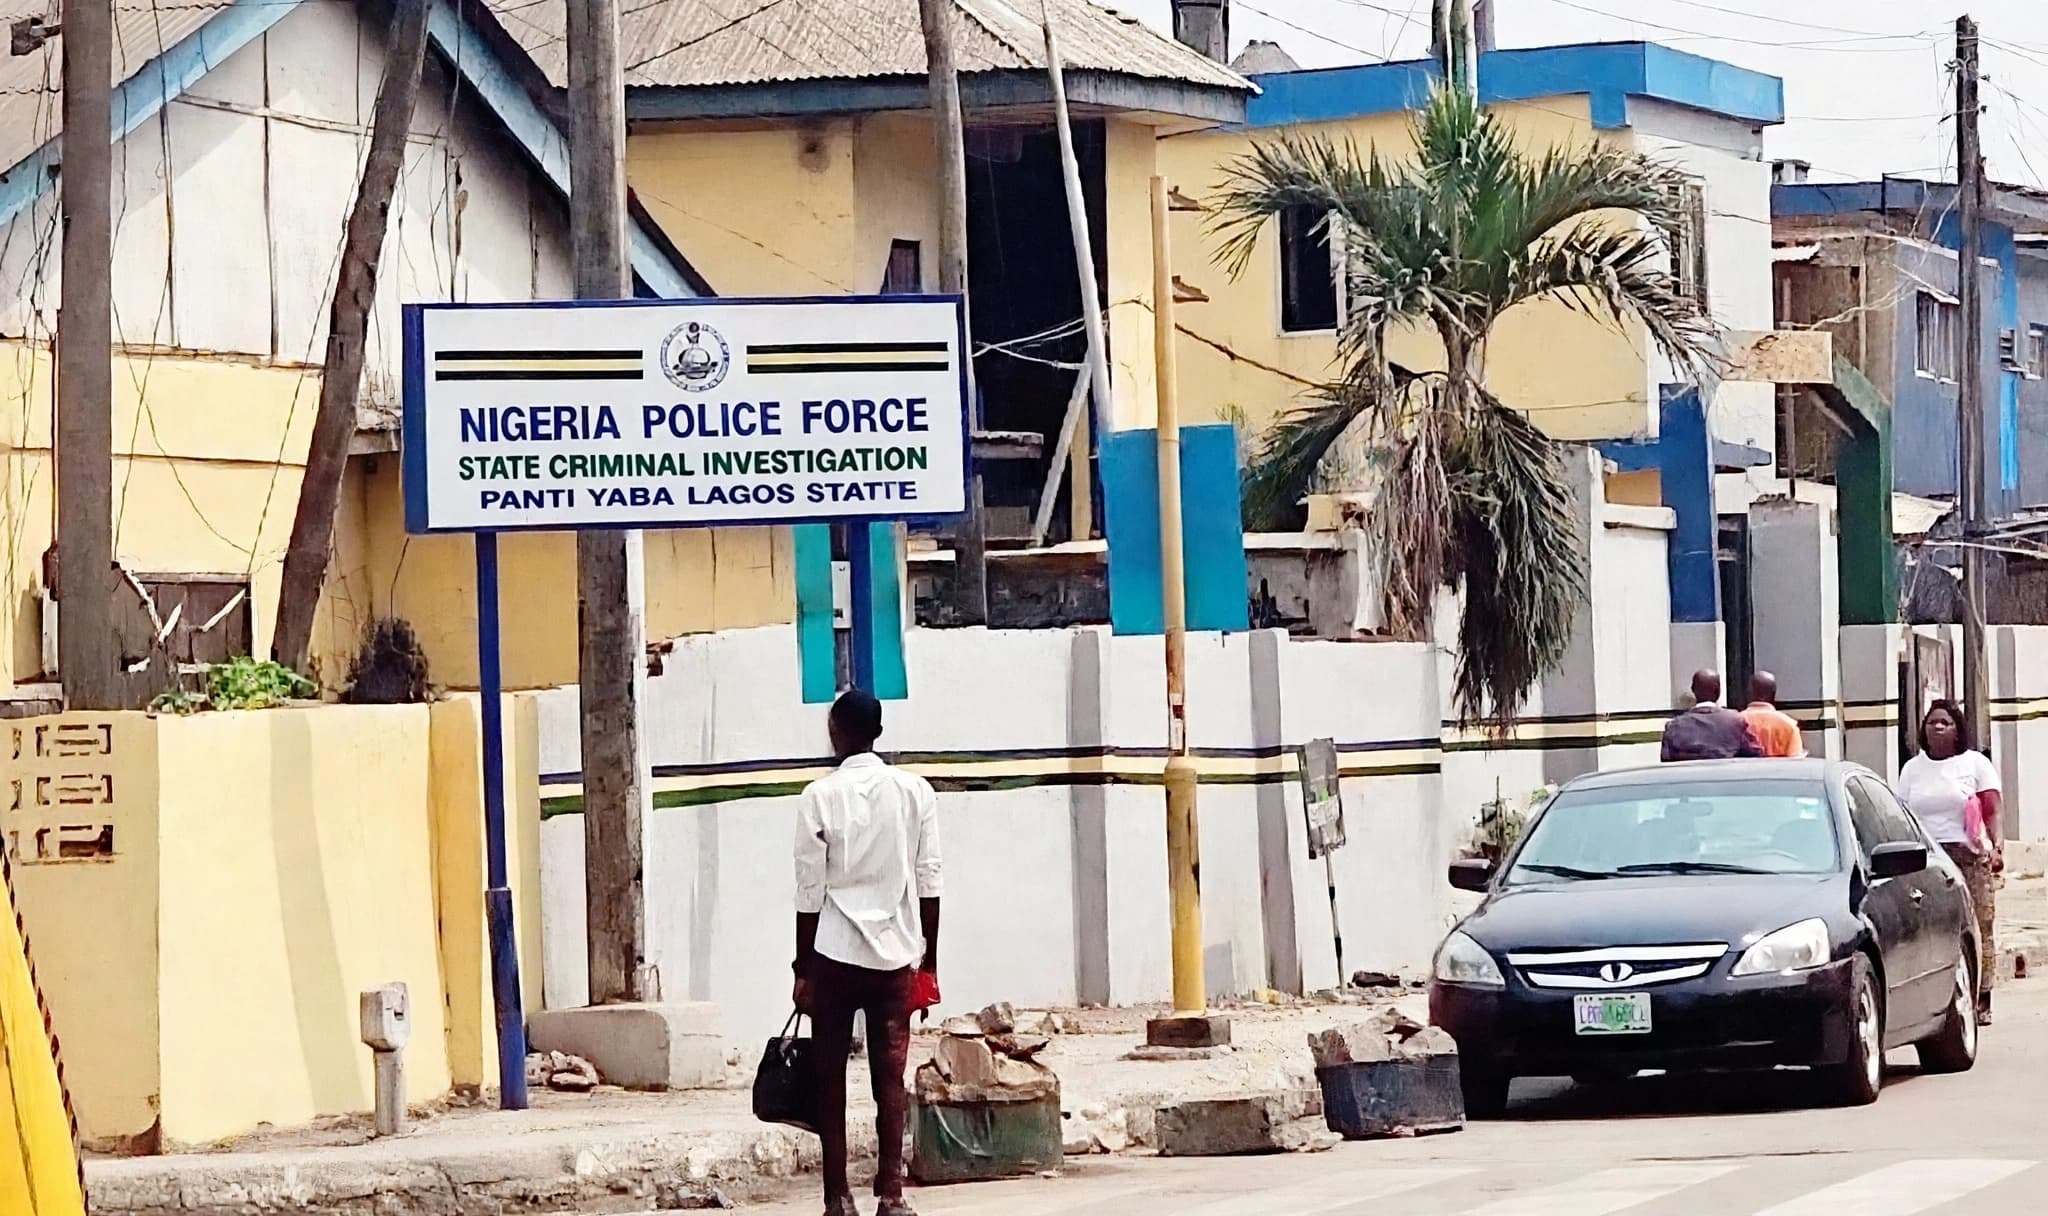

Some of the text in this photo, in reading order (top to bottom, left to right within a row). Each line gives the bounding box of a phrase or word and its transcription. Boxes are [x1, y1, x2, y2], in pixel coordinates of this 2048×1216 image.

[459, 397, 929, 443] NIGERIA POLICE FORCE
[458, 446, 928, 481] STATE CRIMINAL INVESTIGATION
[480, 488, 575, 510] PANTI
[587, 487, 675, 507] YABA
[687, 483, 795, 505] LAGOS
